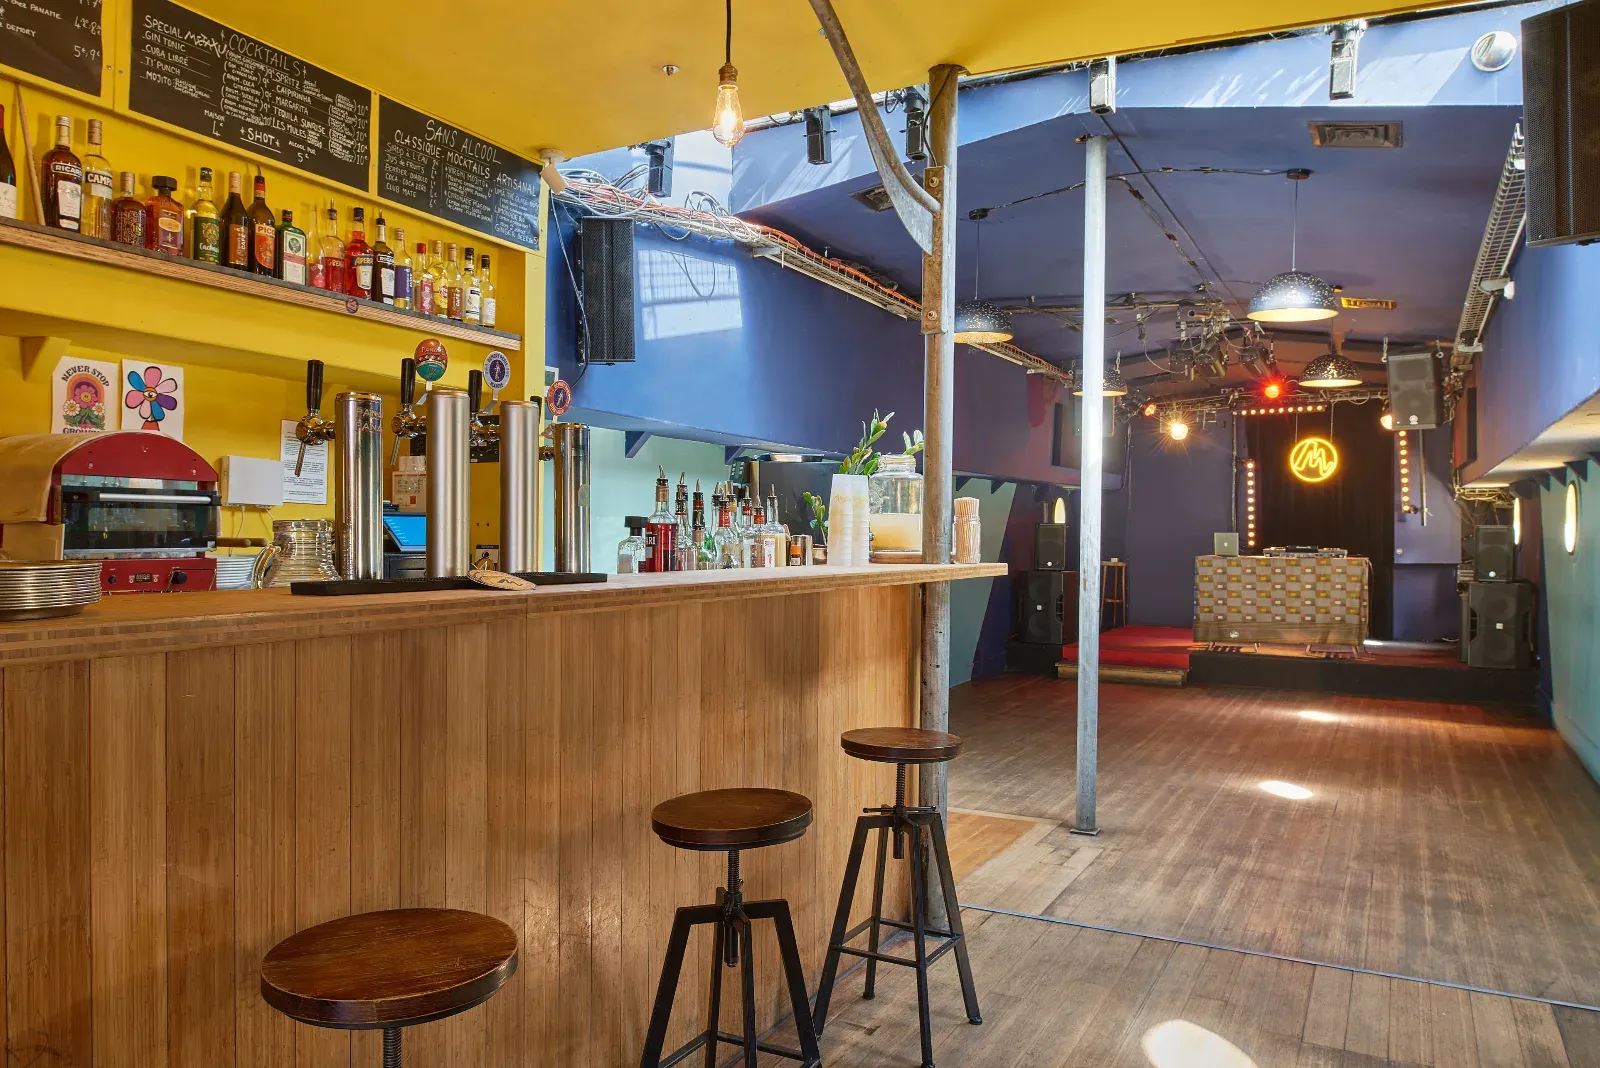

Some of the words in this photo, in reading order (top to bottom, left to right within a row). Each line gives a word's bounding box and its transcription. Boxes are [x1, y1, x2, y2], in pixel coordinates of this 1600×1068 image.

[30, 4, 62, 19] PANAME
[5, 23, 36, 37] DEMORY
[145, 14, 183, 39] SPECIAL
[145, 30, 161, 43] GIN
[162, 36, 186, 52] TONIC
[145, 44, 166, 58] CUBA
[229, 33, 301, 77] COCKTAILS
[157, 61, 181, 76] PUNCH
[146, 70, 172, 86] MOJITO
[276, 72, 300, 89] SPRITZ
[275, 96, 309, 116] MARGARITA
[204, 109, 225, 121] MAISON
[272, 105, 299, 124] TEQUILA
[300, 118, 326, 135] SUNRISE
[247, 127, 276, 146] SHOT
[272, 117, 286, 131] LES
[286, 123, 307, 139] MULES
[288, 140, 306, 151] ALCOOL
[386, 142, 405, 159] SIROP
[425, 119, 458, 148] SANS
[461, 138, 502, 165] ALCOOL
[386, 154, 398, 165] JUS
[406, 160, 424, 174] FRUITS
[394, 129, 442, 159] CLASSIQUE
[446, 151, 490, 180] MOCKTAILS
[496, 172, 537, 197] ARTISANAL
[385, 172, 397, 183] COCA
[402, 177, 414, 188] COCA
[466, 173, 486, 188] MOJITO
[386, 182, 400, 194] CLUB
[402, 188, 417, 198] MATE
[495, 223, 516, 238] GINGER
[61, 365, 91, 382] NEVER
[91, 368, 110, 388] STOP
